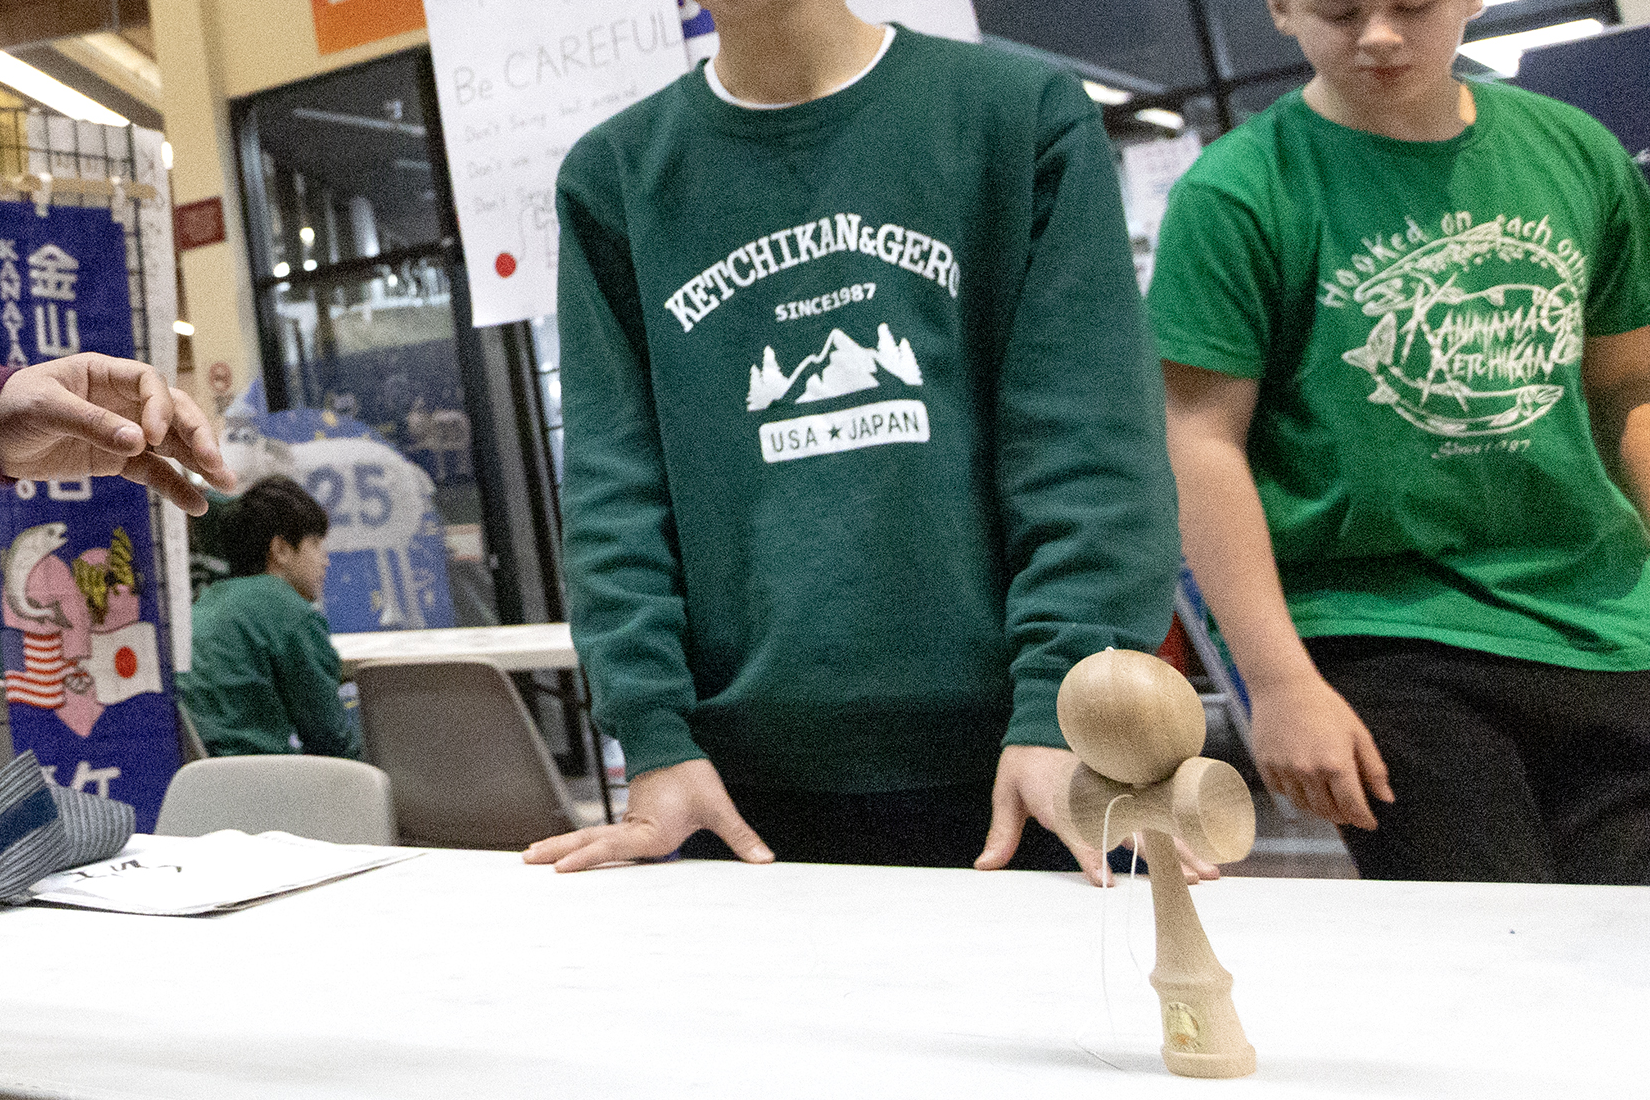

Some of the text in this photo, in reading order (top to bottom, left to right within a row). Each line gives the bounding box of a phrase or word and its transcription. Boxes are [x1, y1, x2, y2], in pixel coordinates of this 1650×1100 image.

[453, 10, 682, 106] Be CAREFUL
[1441, 210, 1472, 236] on
[770, 409, 921, 454] USA JAPAN
[305, 462, 393, 530] 25
